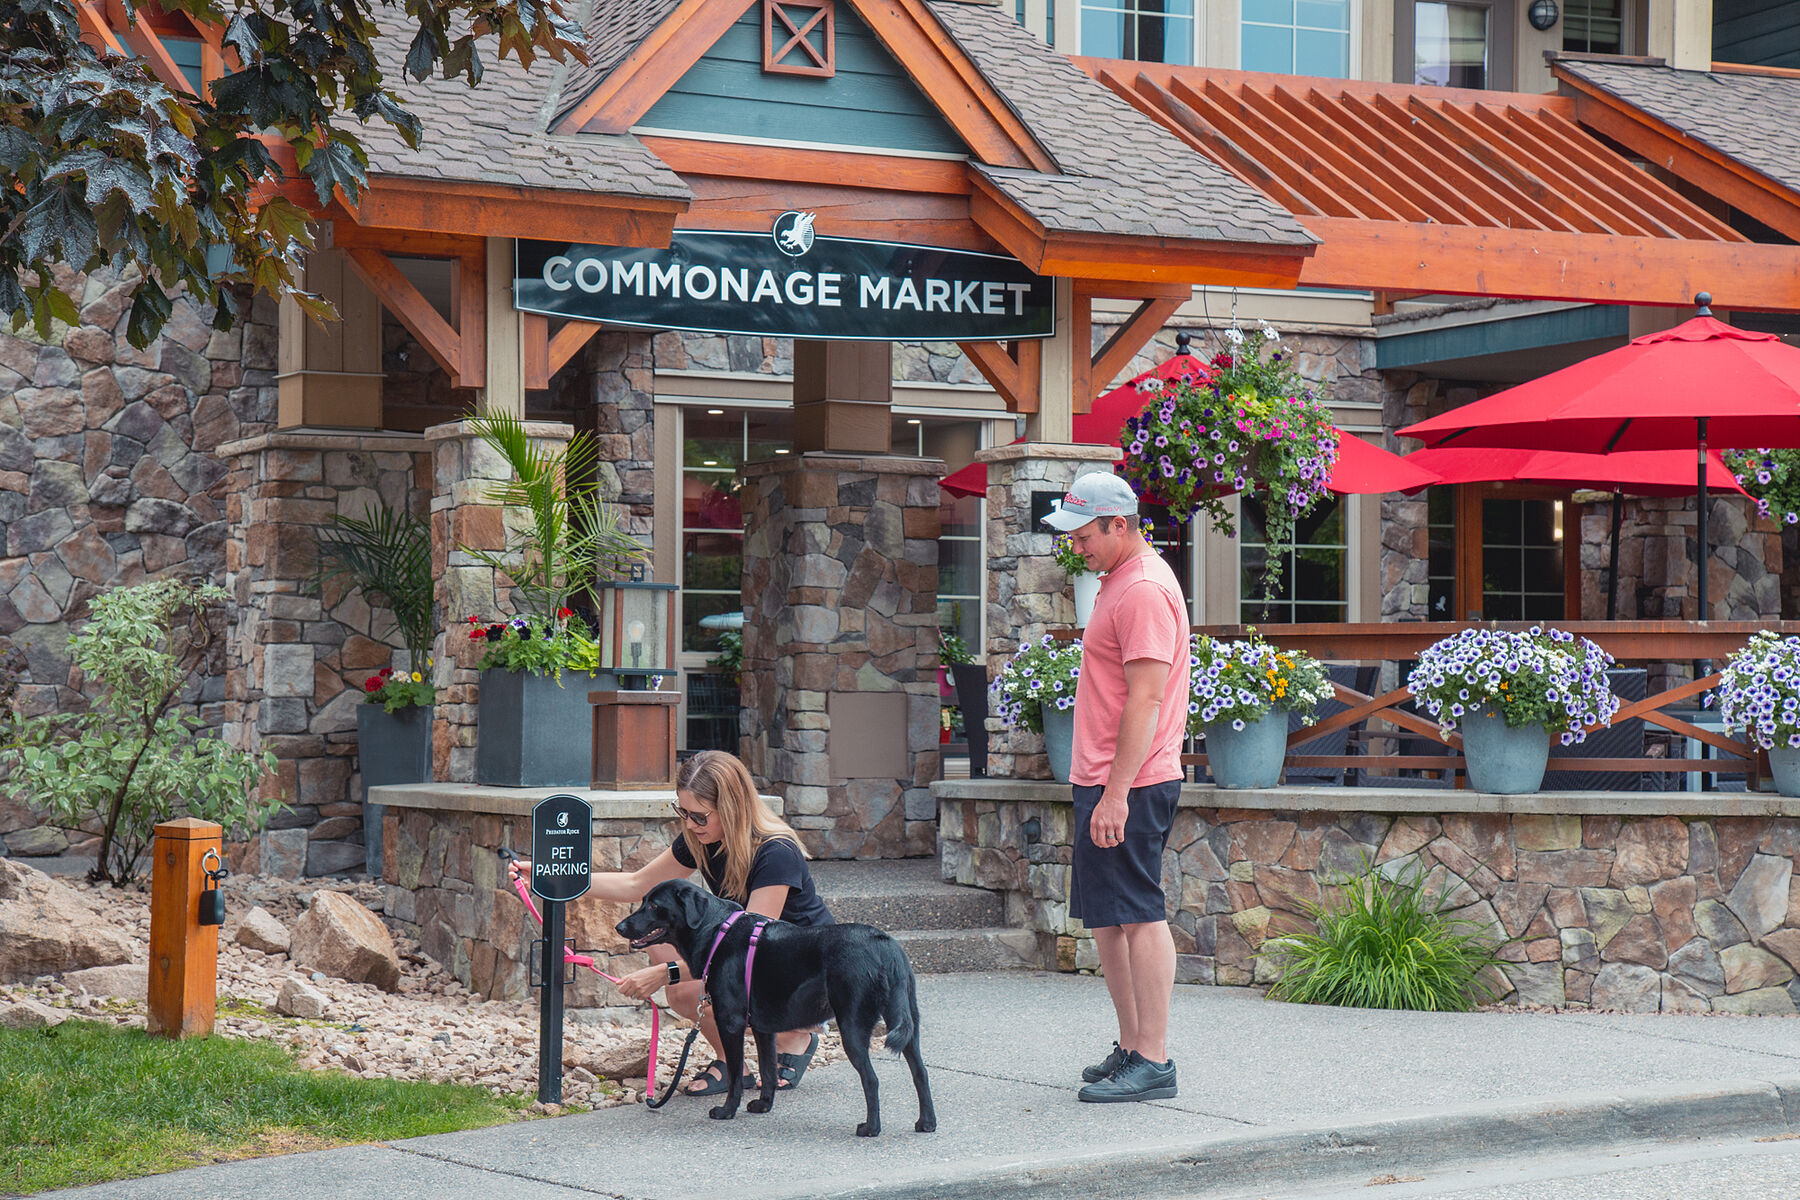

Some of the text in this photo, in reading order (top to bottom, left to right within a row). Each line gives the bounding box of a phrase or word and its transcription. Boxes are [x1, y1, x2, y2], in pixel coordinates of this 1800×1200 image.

[542, 256, 1032, 317] COMMONAGE MARKET
[551, 847, 574, 860] PET
[536, 862, 588, 877] PARKING
